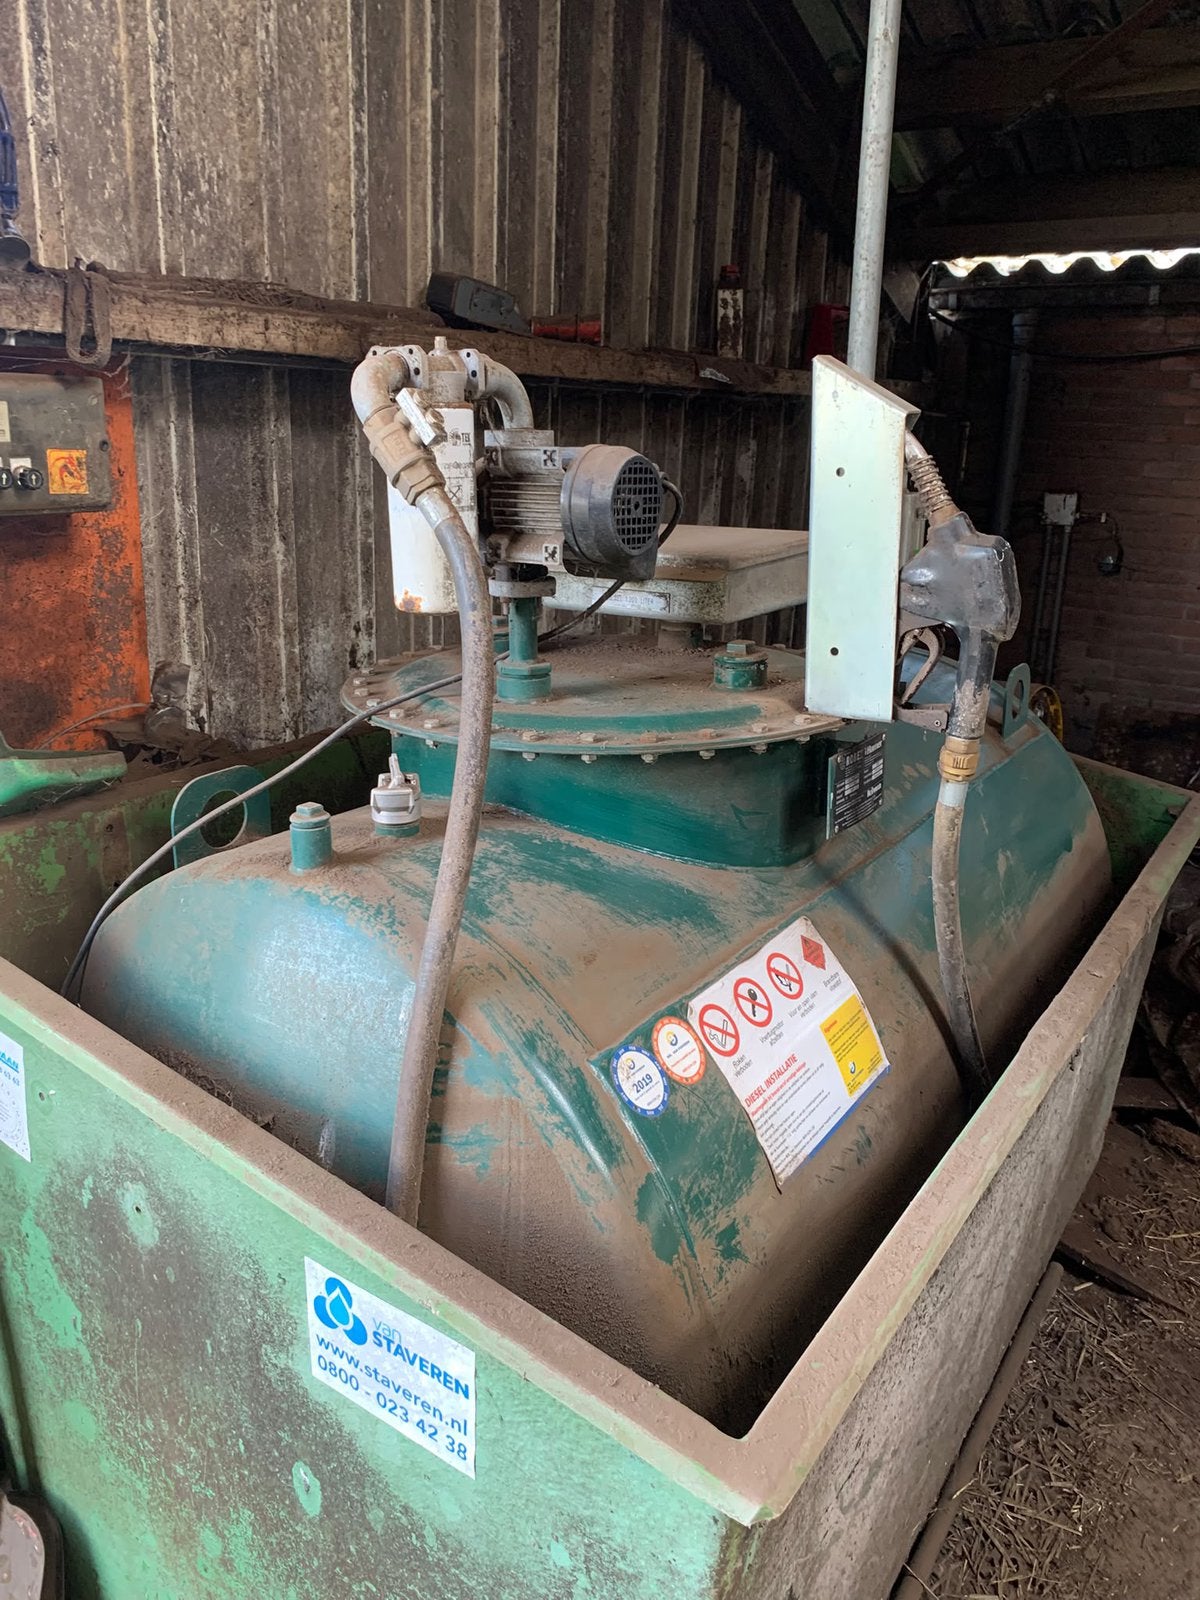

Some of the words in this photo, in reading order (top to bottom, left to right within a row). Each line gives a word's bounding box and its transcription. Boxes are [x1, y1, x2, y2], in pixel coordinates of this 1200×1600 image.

[632, 1073, 653, 1094] 2019
[744, 1084, 766, 1108] DIESEL
[764, 1053, 798, 1089] INSTALLATIE
[372, 1317, 402, 1345] van
[316, 1333, 468, 1437] www.staveren.nl
[372, 1330, 470, 1400] STAVEREN
[318, 1354, 359, 1391] 0800
[376, 1391, 409, 1423] 023
[416, 1418, 438, 1442] 42
[445, 1434, 468, 1461] 38
